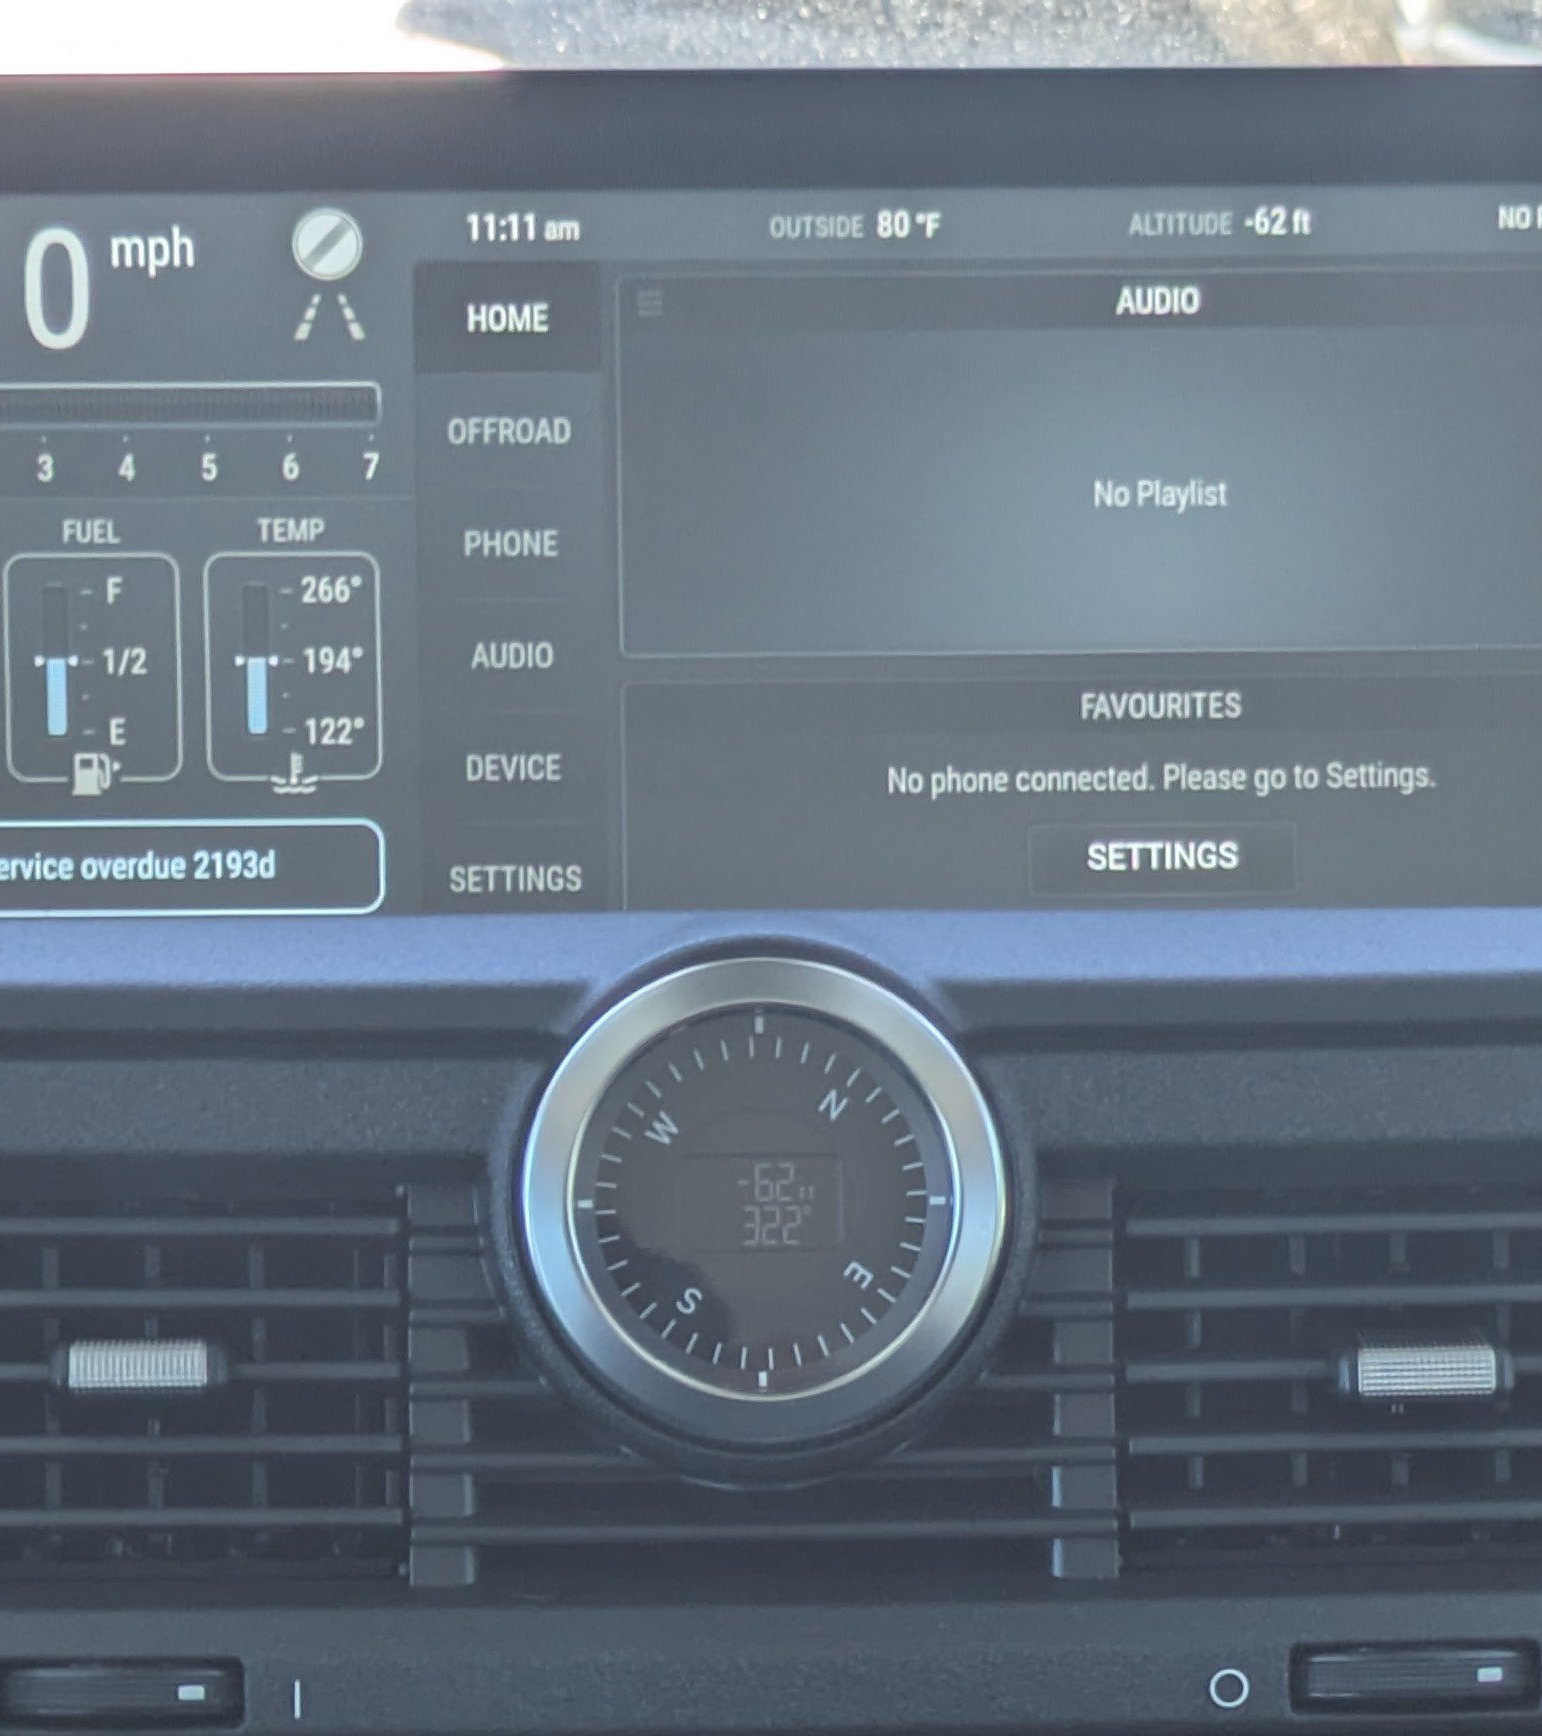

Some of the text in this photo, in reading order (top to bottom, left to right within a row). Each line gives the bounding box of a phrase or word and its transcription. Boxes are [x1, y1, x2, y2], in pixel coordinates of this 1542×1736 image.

[466, 212, 581, 242] 11:11 am
[769, 214, 864, 239] OUTSIDE
[876, 209, 911, 239] 80
[1128, 205, 1311, 237] ALTITUDE -62 ft
[1498, 204, 1532, 230] NO
[110, 224, 195, 278] mph
[24, 226, 90, 350] 0
[1116, 285, 1201, 315] AUDIO
[467, 302, 549, 333] HOME
[447, 416, 572, 445] OFFROAD
[37, 453, 54, 482] 3
[118, 453, 136, 481] 4
[201, 452, 218, 482] 5
[282, 452, 300, 481] 6
[363, 451, 380, 480] 7
[1094, 479, 1227, 514] No Playlist
[62, 518, 121, 545] FUEL
[257, 517, 325, 543] TEMP
[464, 528, 559, 557] PHONE
[106, 575, 123, 604] F
[301, 575, 362, 604] 266°
[103, 646, 147, 676] 1/2
[303, 646, 364, 674] 194°
[471, 641, 554, 669] AUDIO
[1081, 690, 1242, 720] FAVOURITES
[109, 717, 126, 746] E
[305, 716, 365, 745] 122°
[466, 753, 561, 782] DEVICE
[888, 761, 1436, 801] No phone connected. Please go to Settings.
[80, 849, 187, 880] overdue
[193, 849, 276, 880] 2193d
[1087, 840, 1239, 871] SETTINGS
[450, 864, 582, 893] SETTINGS
[818, 1088, 849, 1121] N
[644, 1110, 679, 1145] W
[843, 1261, 874, 1290] E
[676, 1287, 703, 1315] S
